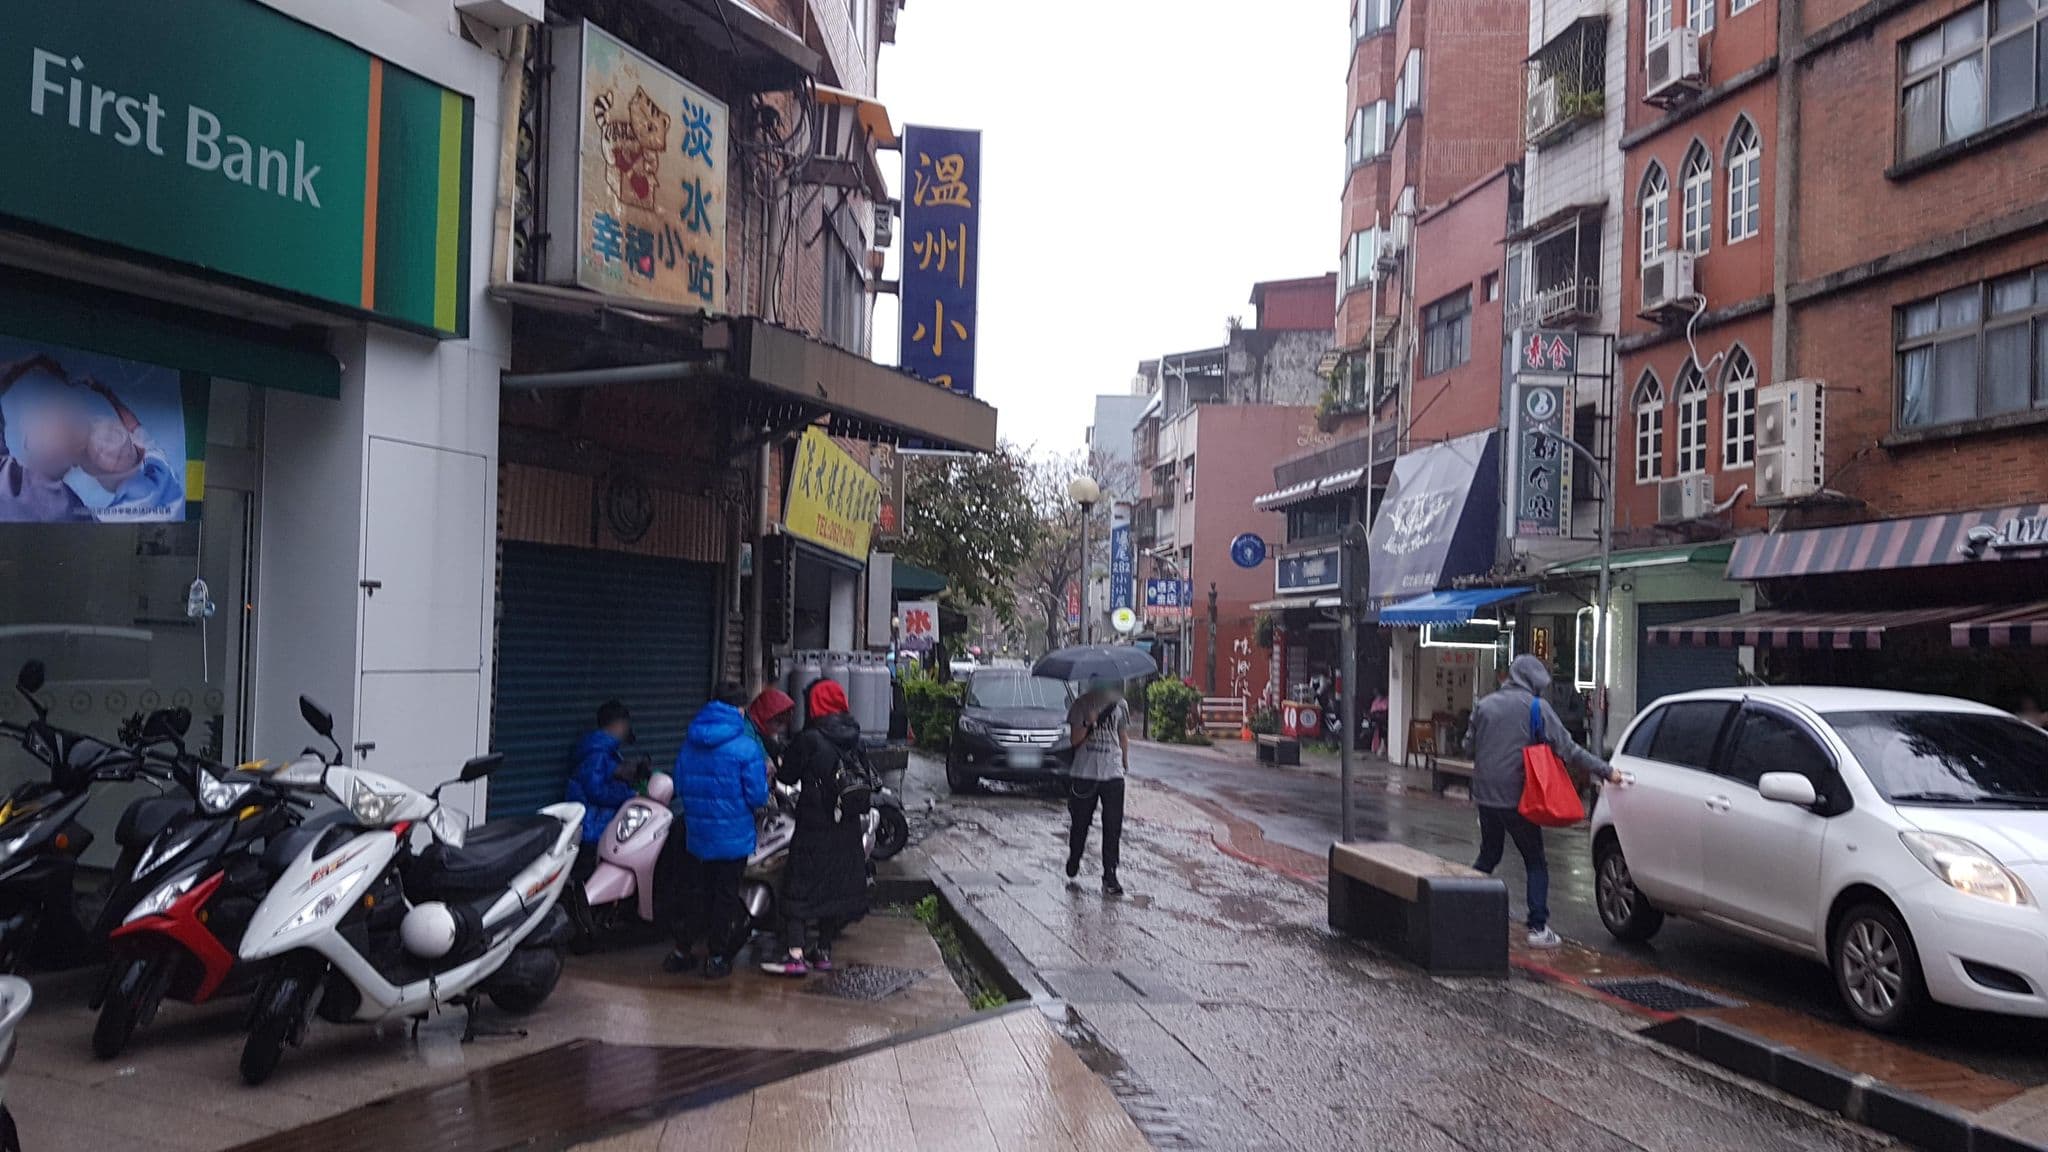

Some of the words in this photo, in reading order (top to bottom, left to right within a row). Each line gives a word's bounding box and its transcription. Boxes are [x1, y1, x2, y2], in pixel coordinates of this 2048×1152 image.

[31, 46, 165, 156] First
[186, 104, 320, 208] Bank
[680, 96, 713, 237] 淡水
[911, 152, 971, 387] 溫州小
